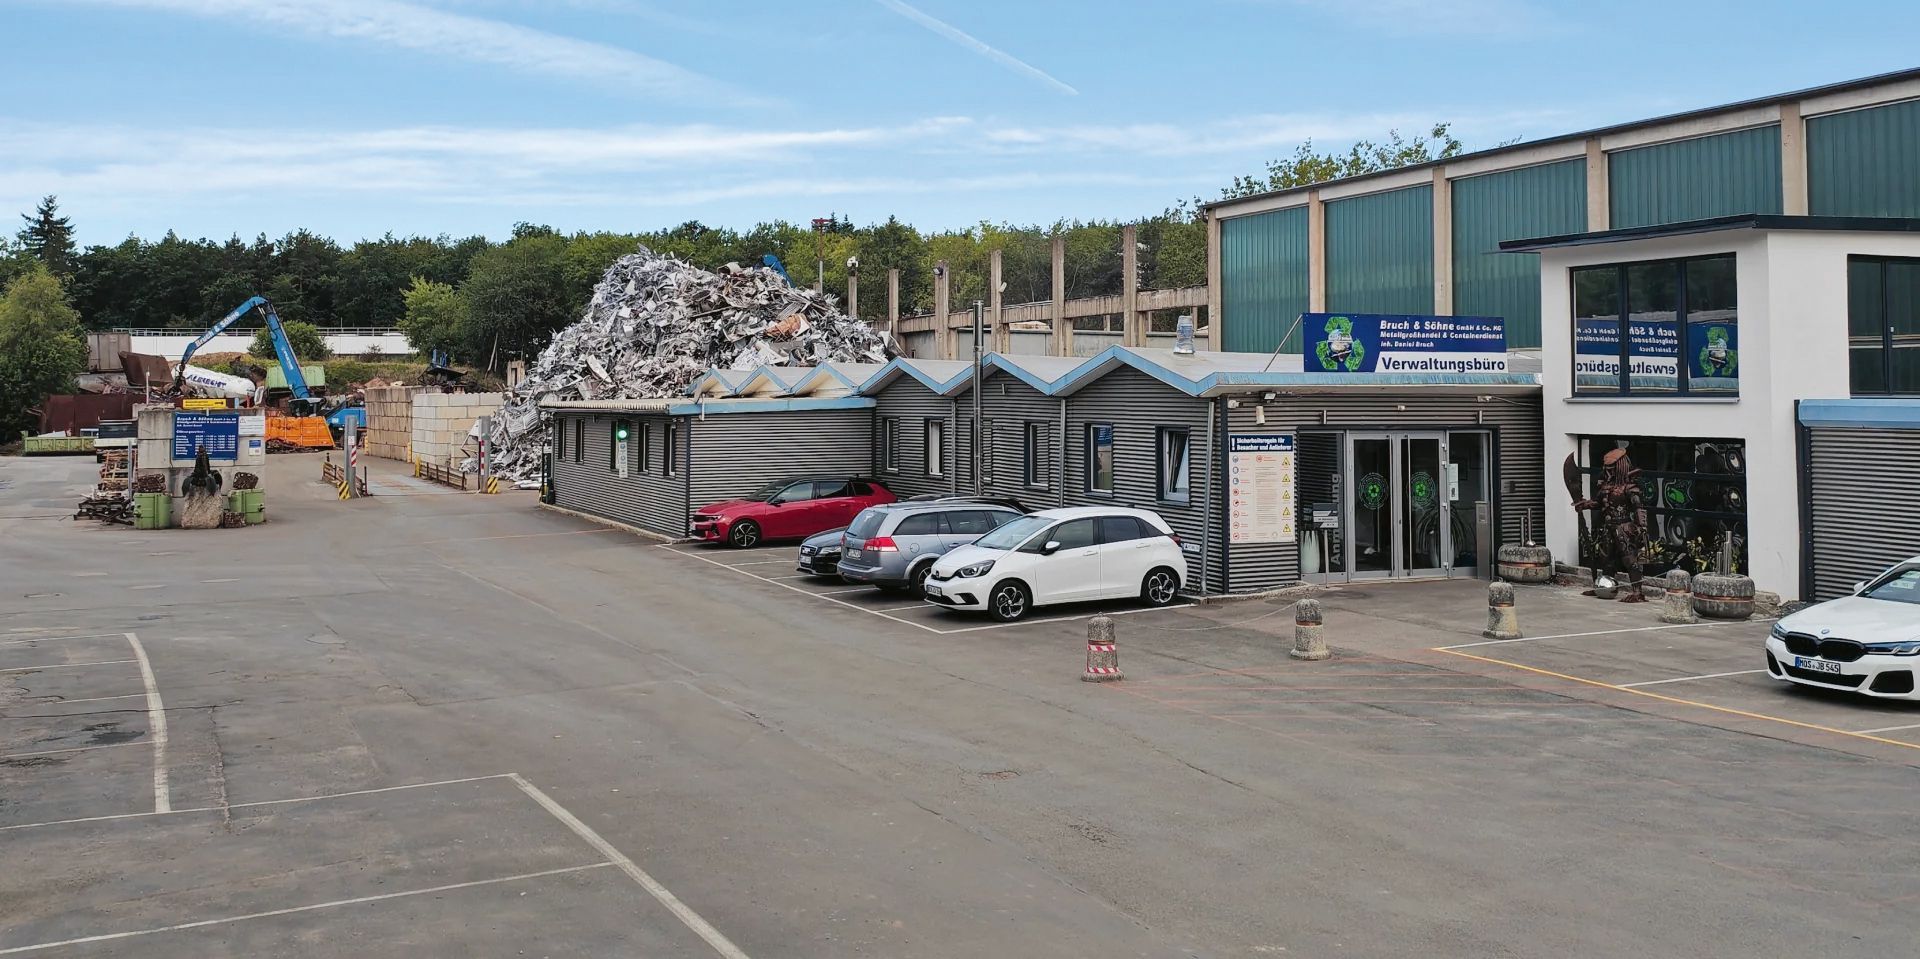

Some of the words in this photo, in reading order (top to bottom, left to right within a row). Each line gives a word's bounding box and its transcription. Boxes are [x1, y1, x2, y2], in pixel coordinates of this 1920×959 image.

[221, 311, 240, 328] Söhne
[1379, 320, 1410, 330] Bruch
[1413, 321, 1420, 330] &
[1424, 320, 1455, 331] Söhne
[1379, 331, 1441, 340] Metallgroßhandel
[1450, 332, 1503, 340] Containerdienst
[1381, 356, 1505, 373] Verwaltungsbüro
[1236, 437, 1277, 445] Sicherheitsregeln
[1800, 660, 1812, 669] MOS
[1816, 662, 1825, 671] JB
[1825, 663, 1839, 673] 545
